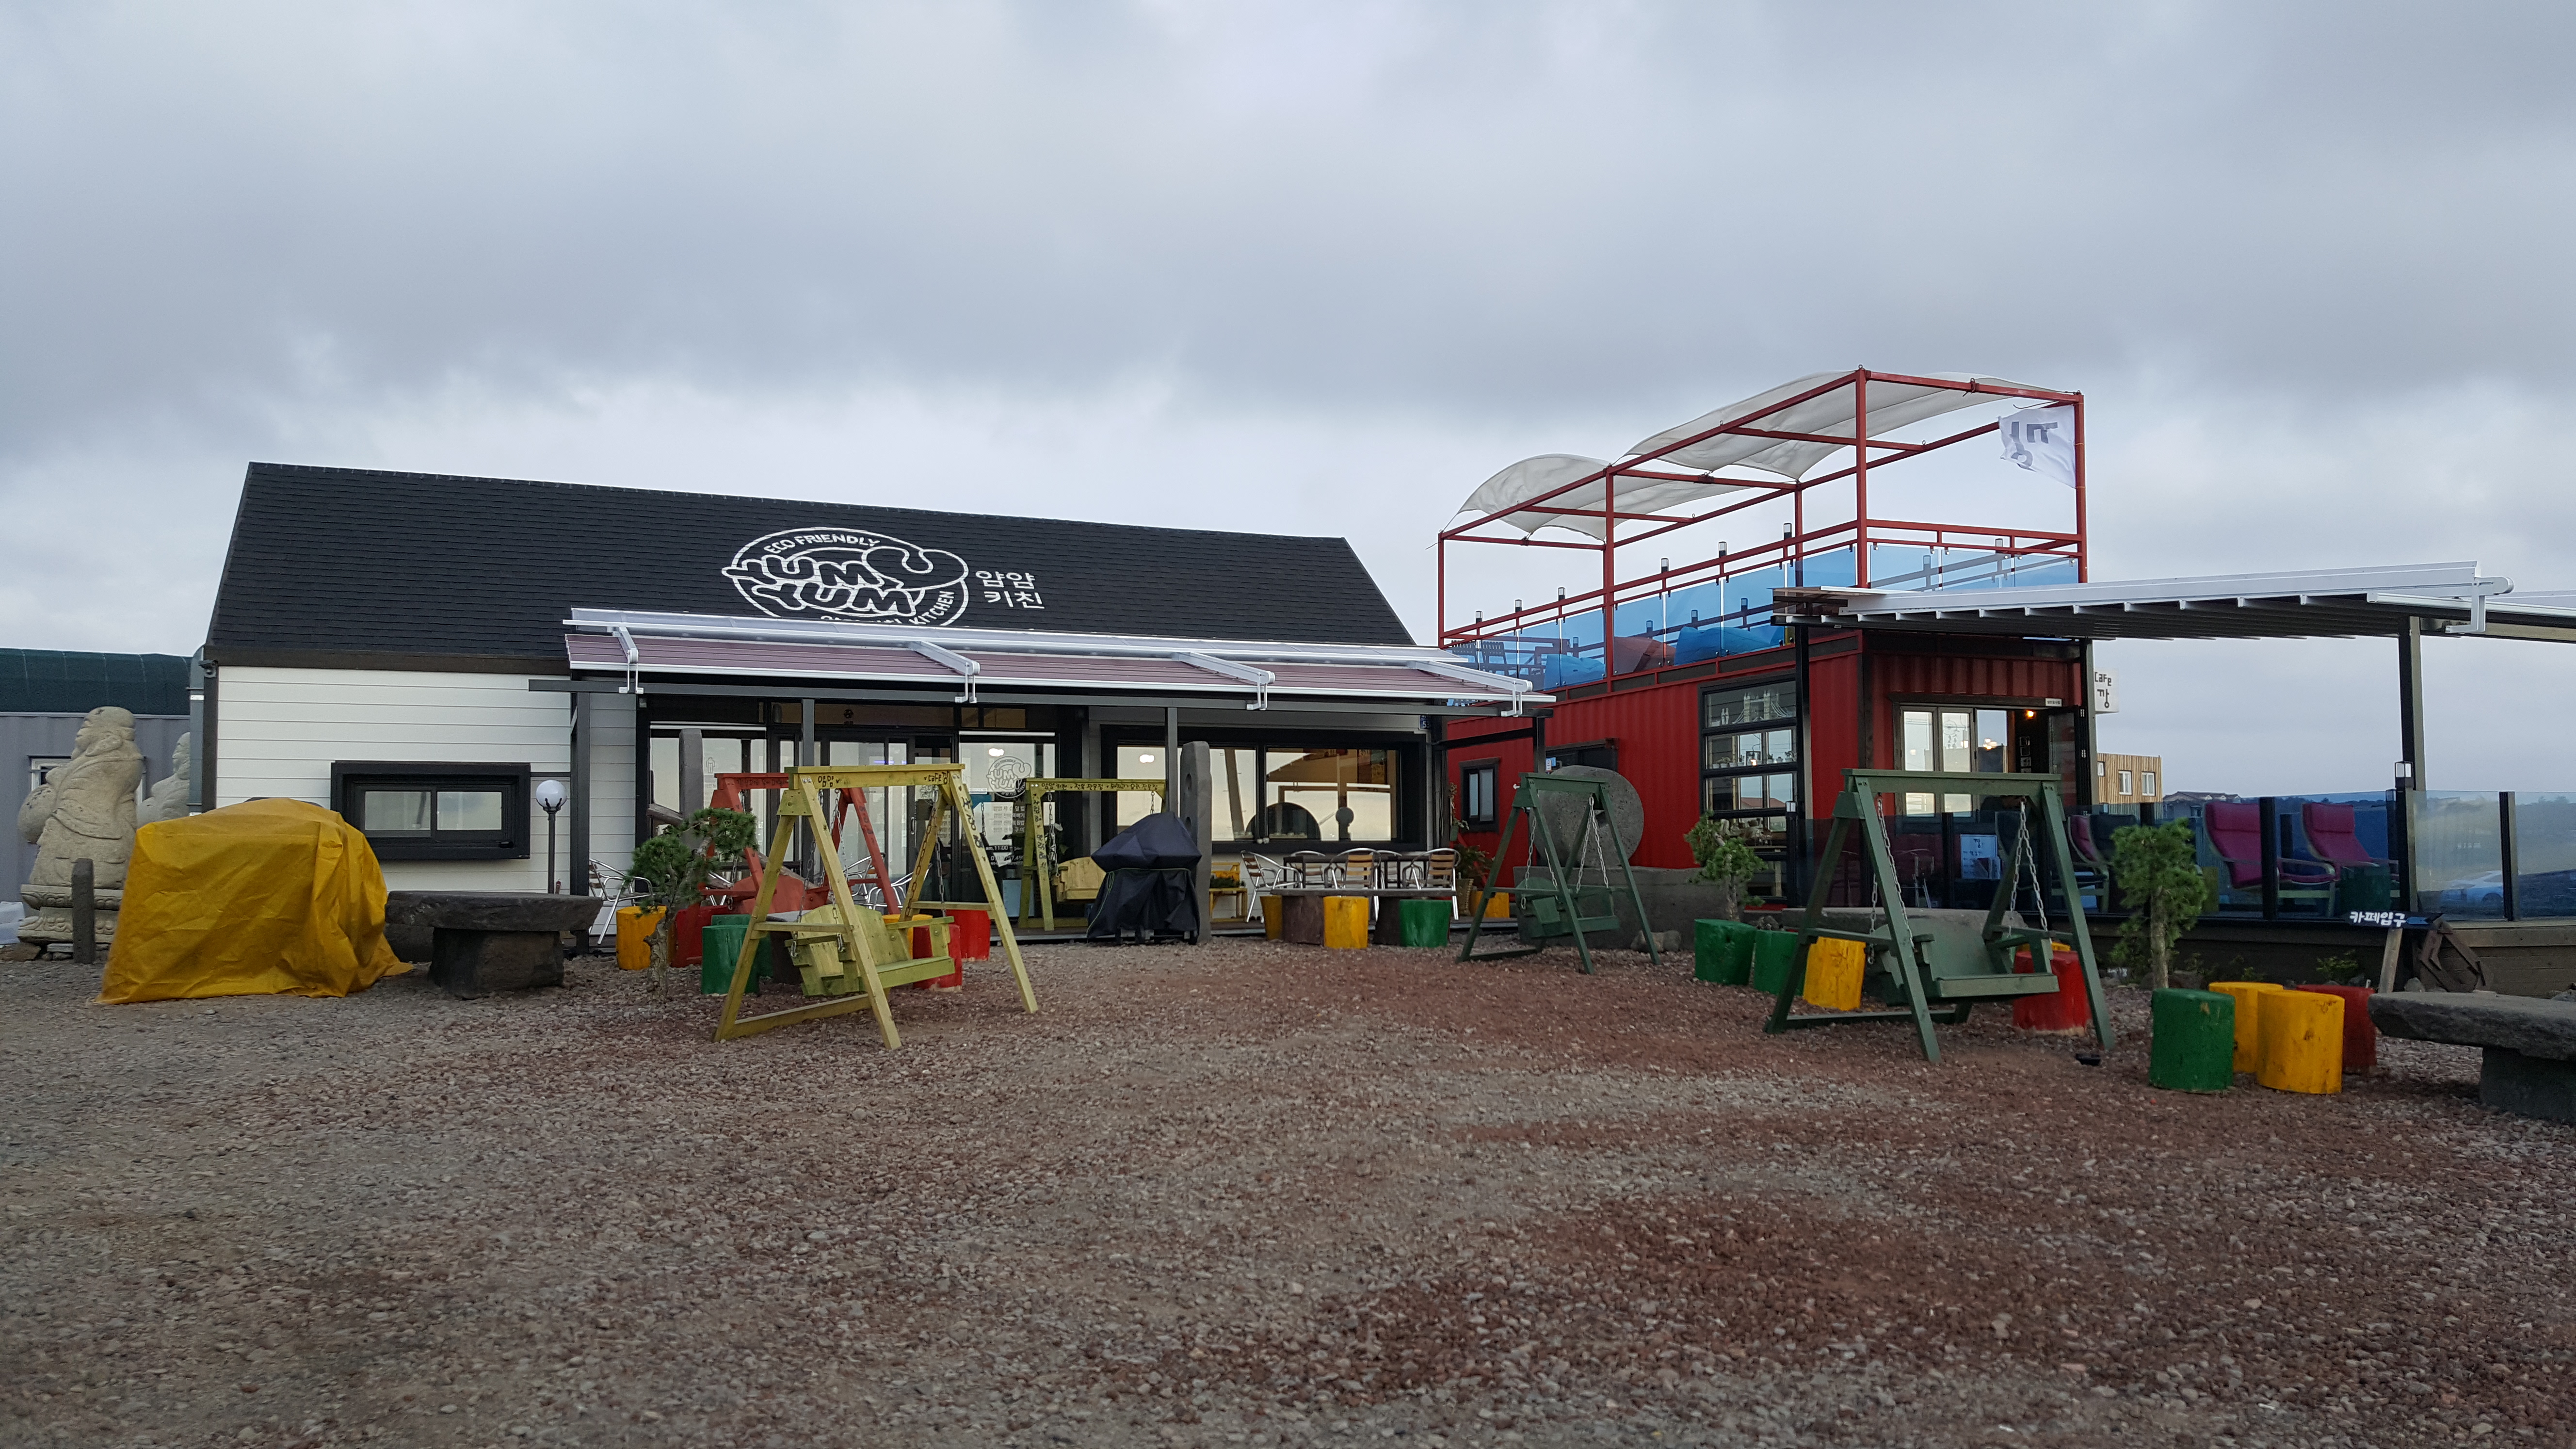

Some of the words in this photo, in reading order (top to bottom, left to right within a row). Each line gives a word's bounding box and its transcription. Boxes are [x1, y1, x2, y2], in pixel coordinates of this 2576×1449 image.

[763, 539, 796, 554] ECO
[794, 533, 881, 547] FRIENDLY
[722, 554, 886, 588] YUM
[975, 571, 1036, 589] 얌얌
[751, 581, 917, 617] YUM
[909, 590, 955, 625] KITCHEN
[983, 591, 1045, 609] 키친
[2097, 689, 2109, 708] 깡
[2350, 911, 2407, 927] 카페입구
